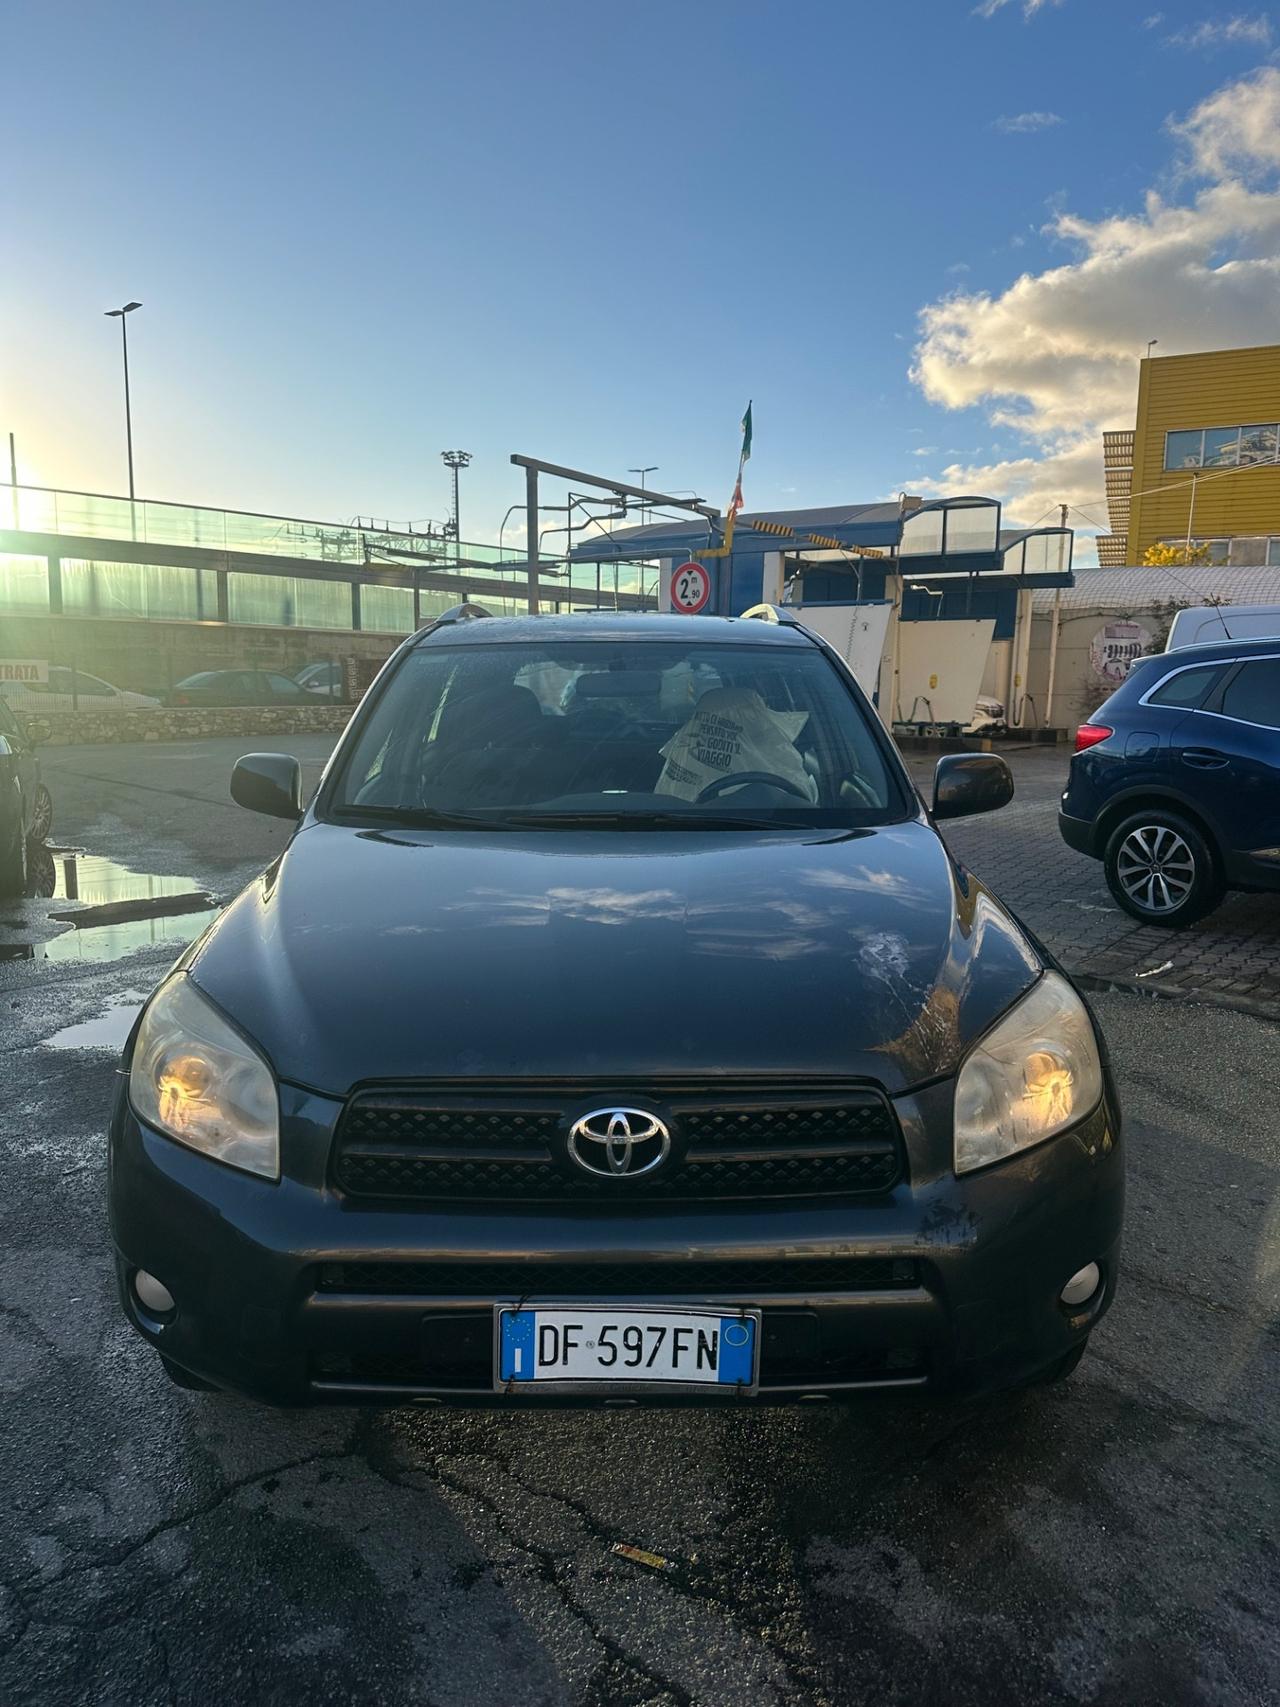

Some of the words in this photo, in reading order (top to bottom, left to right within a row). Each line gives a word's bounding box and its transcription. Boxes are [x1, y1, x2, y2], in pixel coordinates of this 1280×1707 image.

[707, 737, 734, 754] GODITI
[697, 746, 732, 767] VIAGGIO
[538, 1324, 583, 1367] DF
[597, 1325, 719, 1371] 597FN
